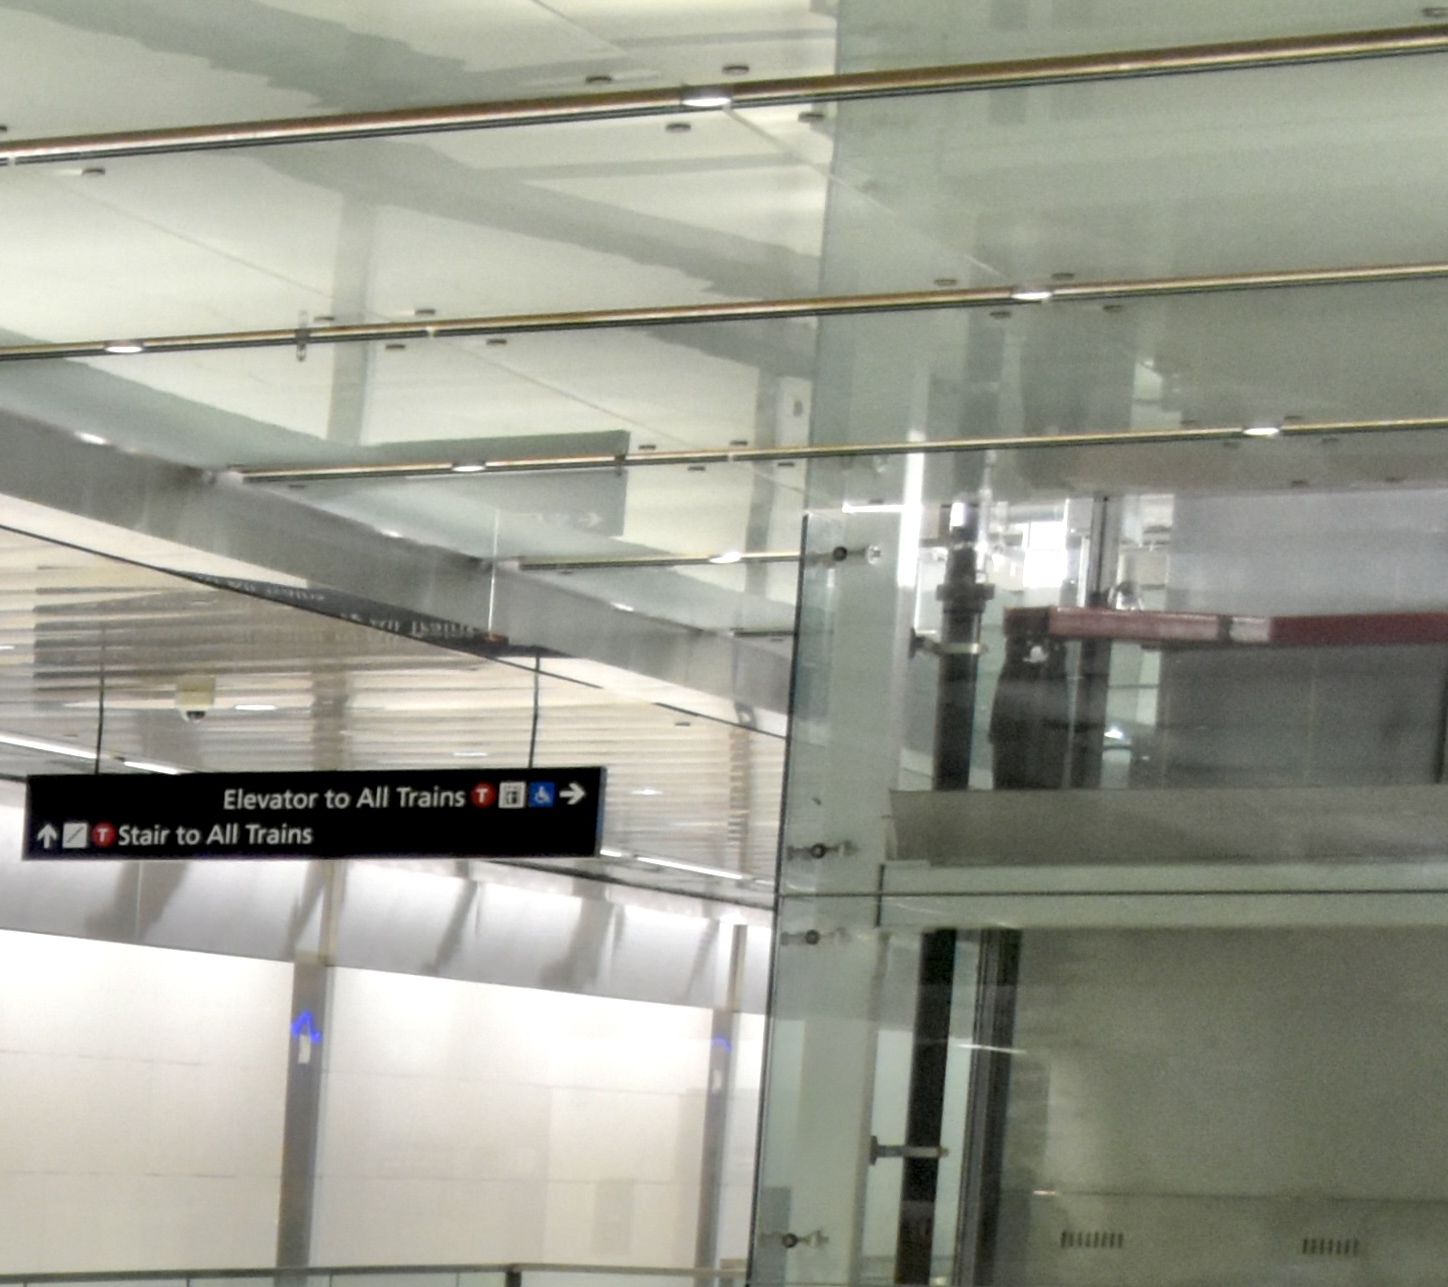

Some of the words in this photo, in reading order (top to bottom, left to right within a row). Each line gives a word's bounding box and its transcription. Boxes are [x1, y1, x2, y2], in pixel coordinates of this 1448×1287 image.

[223, 788, 317, 810] Elevator
[324, 790, 350, 810] to
[357, 787, 389, 809] All
[397, 785, 466, 808] Trains
[118, 824, 169, 846] Stair
[176, 825, 200, 845] to
[207, 824, 240, 844] All
[246, 823, 313, 845] Trains
